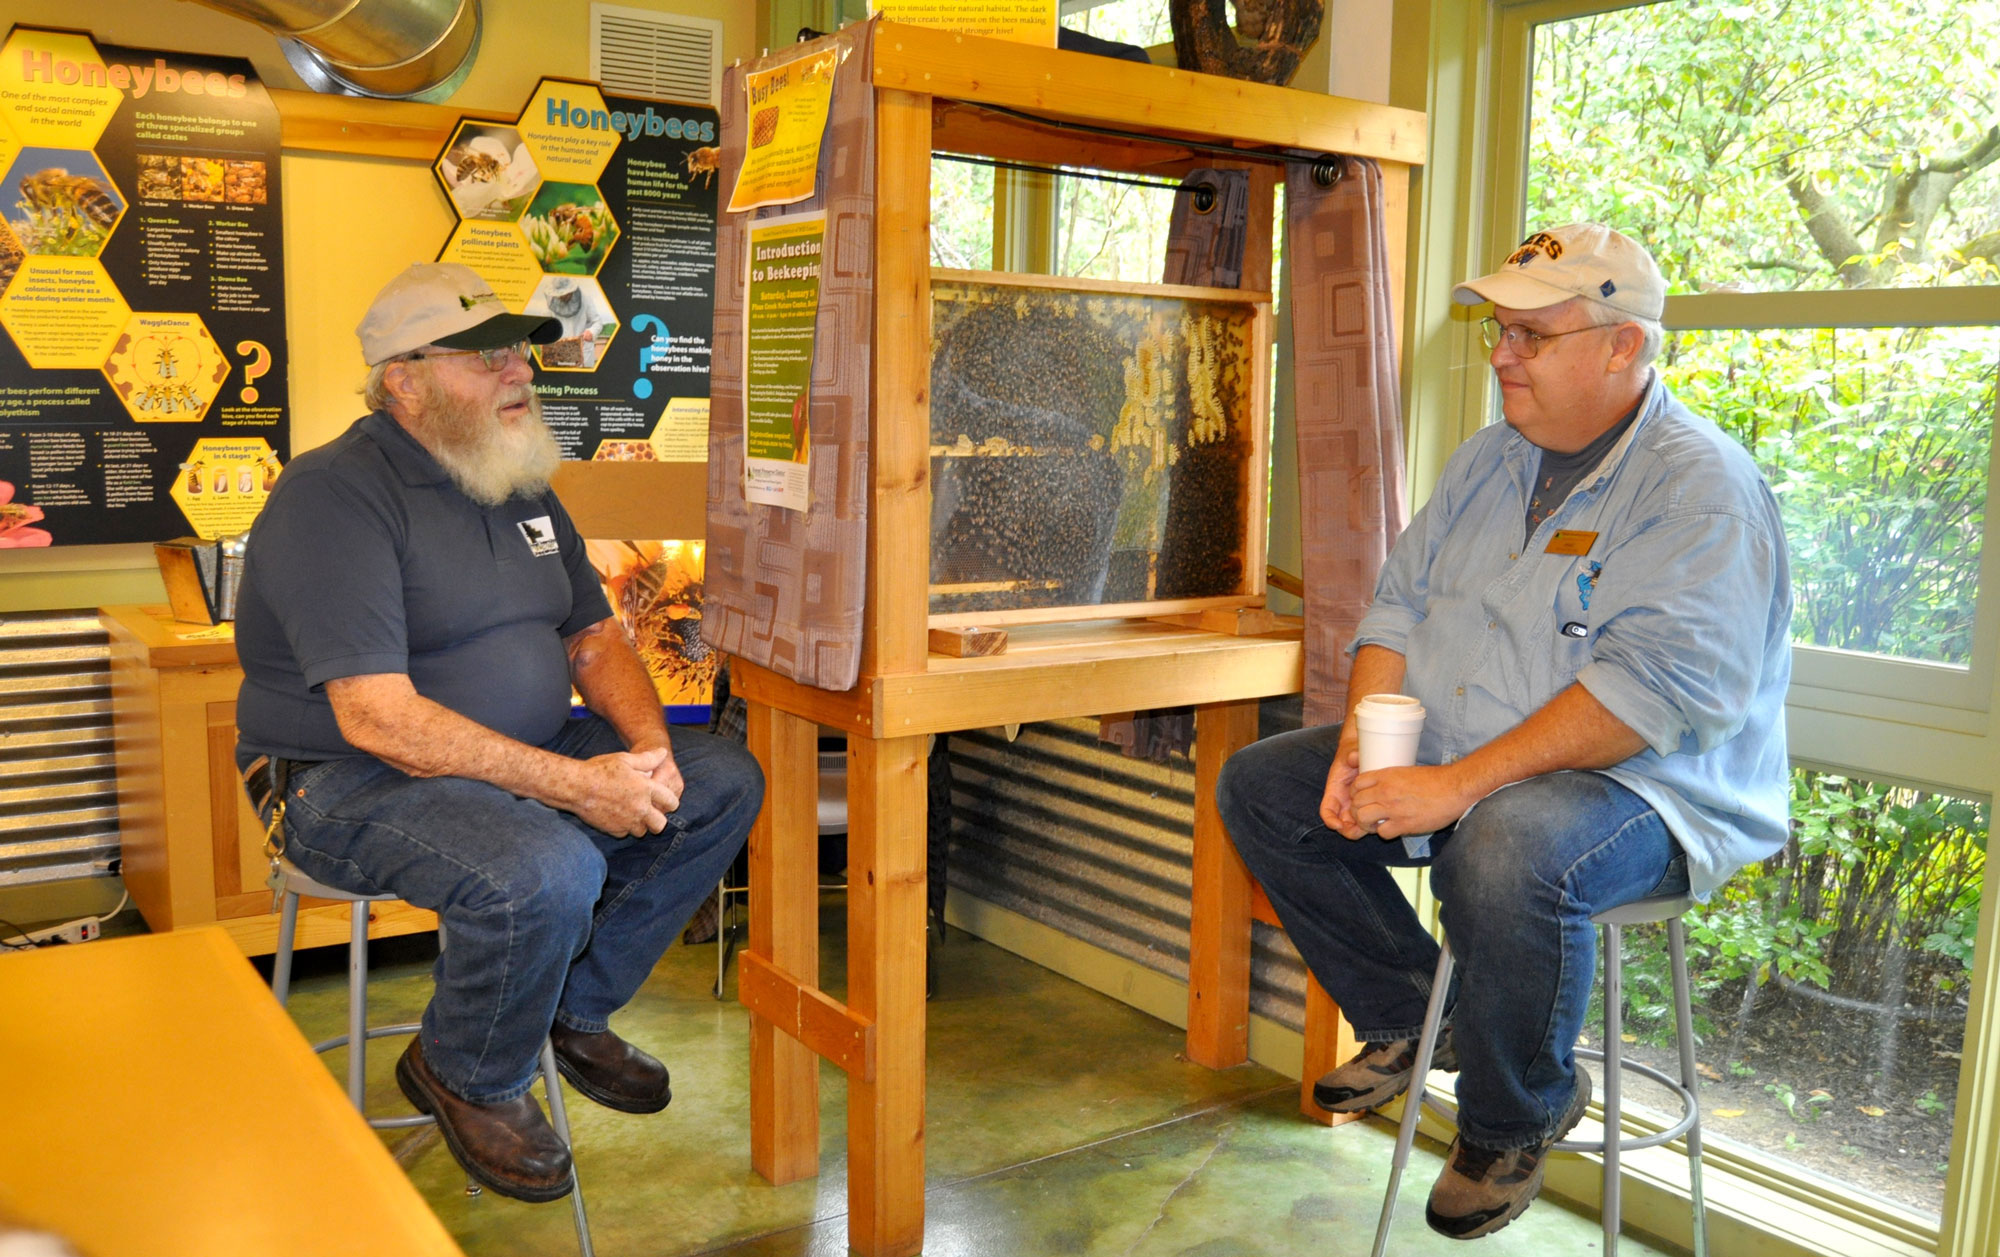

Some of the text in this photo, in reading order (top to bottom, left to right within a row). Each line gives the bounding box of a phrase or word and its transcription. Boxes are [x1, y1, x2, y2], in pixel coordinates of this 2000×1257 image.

[1020, 17, 1046, 25] making
[21, 49, 247, 99] Honeybees
[752, 65, 789, 105] Busy Bees!
[1, 90, 108, 106] One of the most complex
[15, 104, 95, 117] and social animals
[30, 116, 39, 124] in
[42, 117, 54, 125] the
[136, 112, 155, 120] Each
[157, 113, 196, 123] honeybee
[198, 117, 230, 127] belongs
[547, 98, 714, 142] Honeybees
[170, 124, 214, 134] specialized
[216, 128, 244, 136] groups
[528, 132, 563, 144] Honeybees
[565, 136, 579, 146] play
[586, 138, 597, 147] key
[547, 155, 571, 163] natural
[627, 158, 666, 169] Honeybees
[627, 168, 679, 180] have benefited
[627, 179, 651, 187] human
[653, 179, 664, 188] life
[676, 182, 688, 190] the
[644, 189, 661, 198] 8000
[663, 191, 681, 200] years
[471, 228, 512, 238] Honeybees
[462, 239, 494, 247] pollinate
[757, 240, 820, 261] Introduction
[753, 269, 764, 282] to
[58, 278, 95, 286] honeybee
[140, 319, 190, 327] WaggleDance
[679, 336, 692, 344] find
[651, 346, 688, 354] honeybees
[651, 355, 672, 363] honey
[29, 388, 63, 396] perform
[65, 387, 100, 395] different
[564, 386, 598, 395] Process
[0, 409, 40, 417] olyethism
